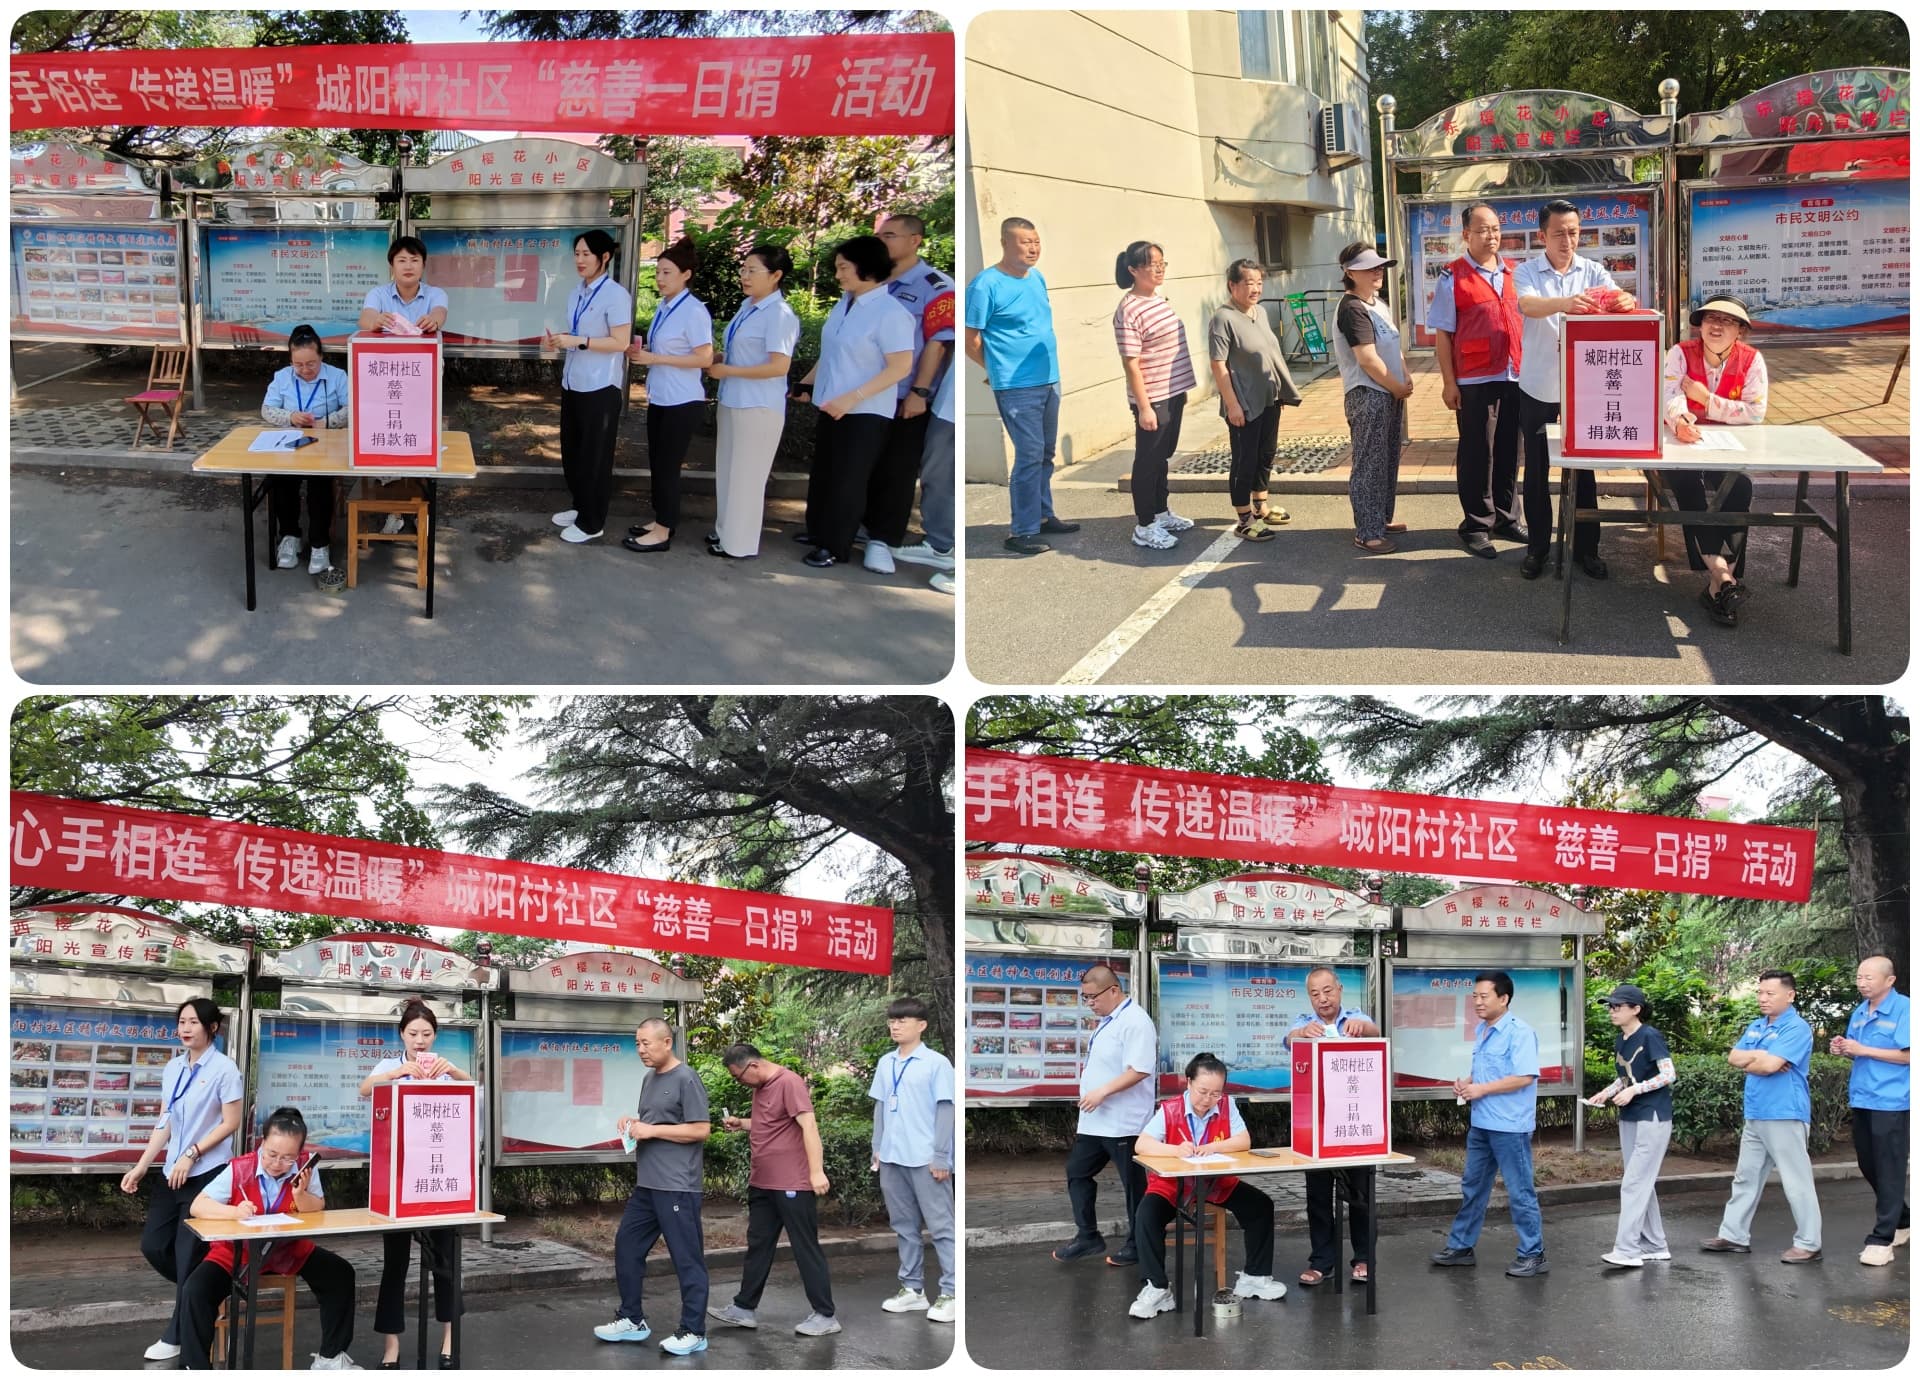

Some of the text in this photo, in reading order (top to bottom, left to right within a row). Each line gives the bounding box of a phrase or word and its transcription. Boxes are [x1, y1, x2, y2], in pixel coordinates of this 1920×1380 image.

[10, 54, 936, 119] 手相连 传递温暖” 城阳村社区 “慈善一日捐” 活动
[1465, 129, 1582, 151] 阳光宣传栏
[451, 149, 591, 174] 西樱花小区
[468, 172, 566, 186] 阳光宣传栏
[1775, 209, 1860, 225] 市民文明公约
[1584, 348, 1644, 367] 城阳村社区
[368, 360, 422, 377] 城阳村社区
[386, 379, 403, 430] 慈善一日捐
[1603, 368, 1623, 423] 慈善一日捐
[371, 432, 418, 448] 捐款箱
[1587, 424, 1639, 441] 捐款箱
[965, 765, 1798, 888] 手相连 传递温暖” 城阳村社区 “慈善一日捐” 活动
[10, 808, 878, 961] 心手相连 传递温暖” 城阳村社区 “慈善一日捐” 活动
[966, 865, 1091, 896] 樱花小区
[976, 890, 1065, 908] 光宣传栏
[1213, 885, 1347, 910] 西樱花小区
[1444, 896, 1561, 918] 西樱花小区
[1232, 903, 1325, 921] 阳光宣传栏
[1461, 915, 1543, 928] 阳光宣传栏
[12, 916, 189, 950] 西樱花小区
[36, 938, 162, 962] 阳光宣传栏
[318, 944, 454, 972] 西樱花小区
[338, 963, 432, 981] 阳光宣传栏
[551, 961, 664, 985] 西樱花小区
[567, 979, 645, 993] 阳光宣传栏
[1231, 987, 1297, 999] 市民文明公约
[1330, 1057, 1375, 1073] 城阳村社区
[413, 1102, 462, 1120] 城阳村社区
[1334, 1124, 1373, 1138] 捐款箱
[429, 1122, 444, 1175] 慈善一日捐
[414, 1177, 459, 1193] 捐款箱
